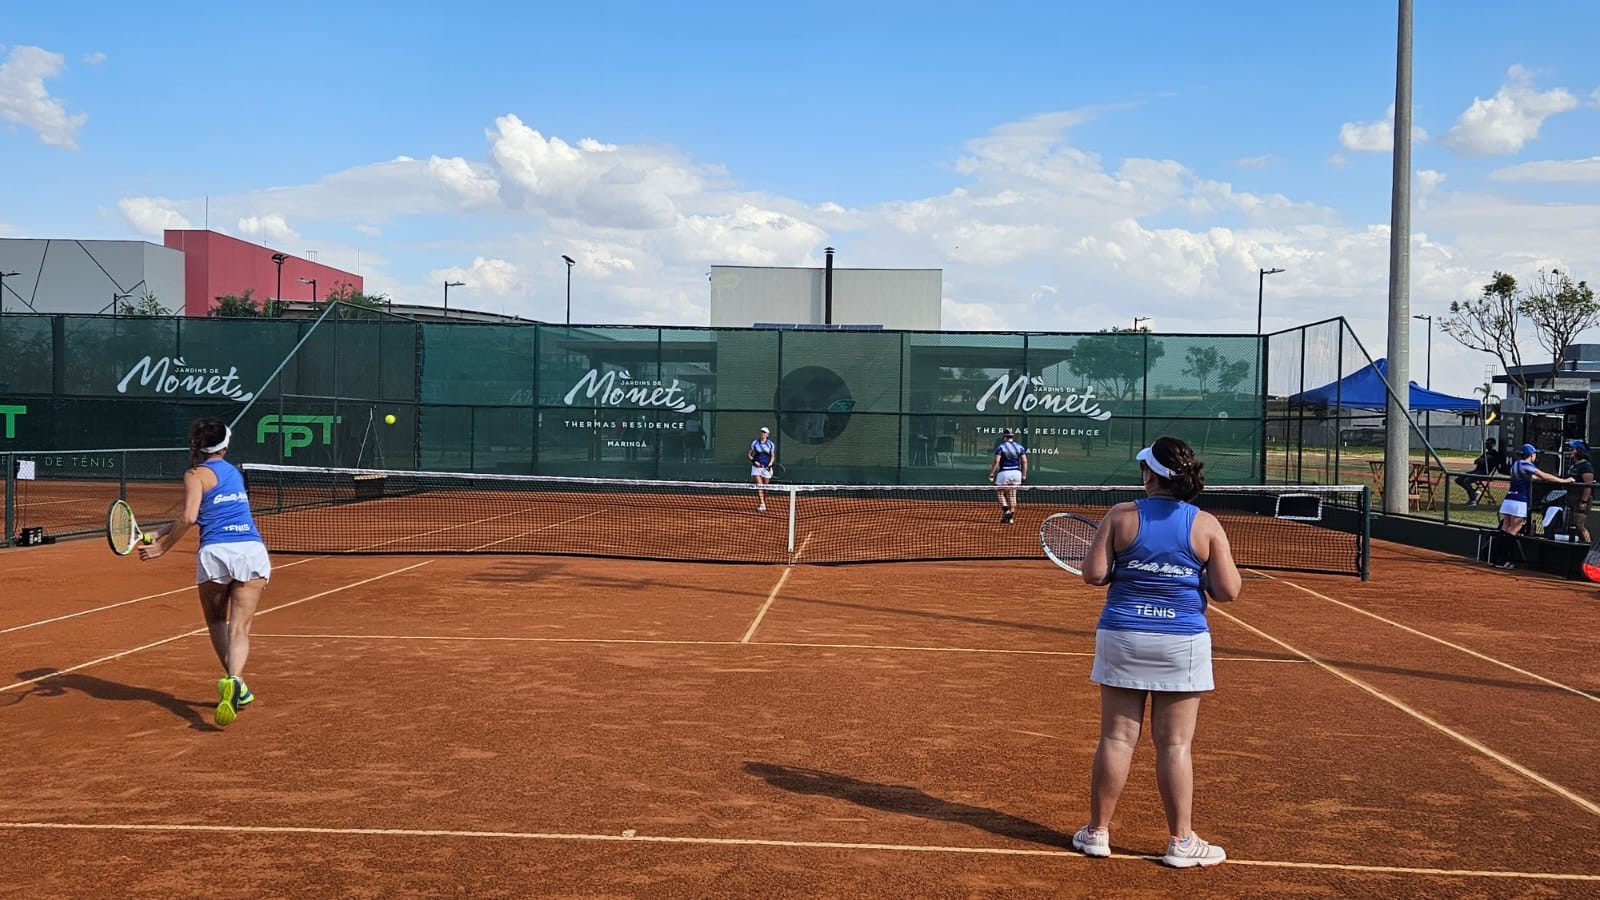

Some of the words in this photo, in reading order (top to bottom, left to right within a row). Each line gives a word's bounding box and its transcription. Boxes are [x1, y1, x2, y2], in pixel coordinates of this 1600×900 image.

[117, 355, 243, 396] Monet
[563, 369, 686, 407] Monet
[976, 374, 1101, 414] Monet
[622, 421, 686, 429] RESIDENCE
[1035, 428, 1100, 436] RESIDENCE
[257, 415, 342, 457] FPT
[1026, 447, 1060, 455] ARINGÁ
[45, 457, 63, 467] DE
[72, 455, 114, 468] TÊNIS
[1135, 603, 1176, 618] TÊNIS
